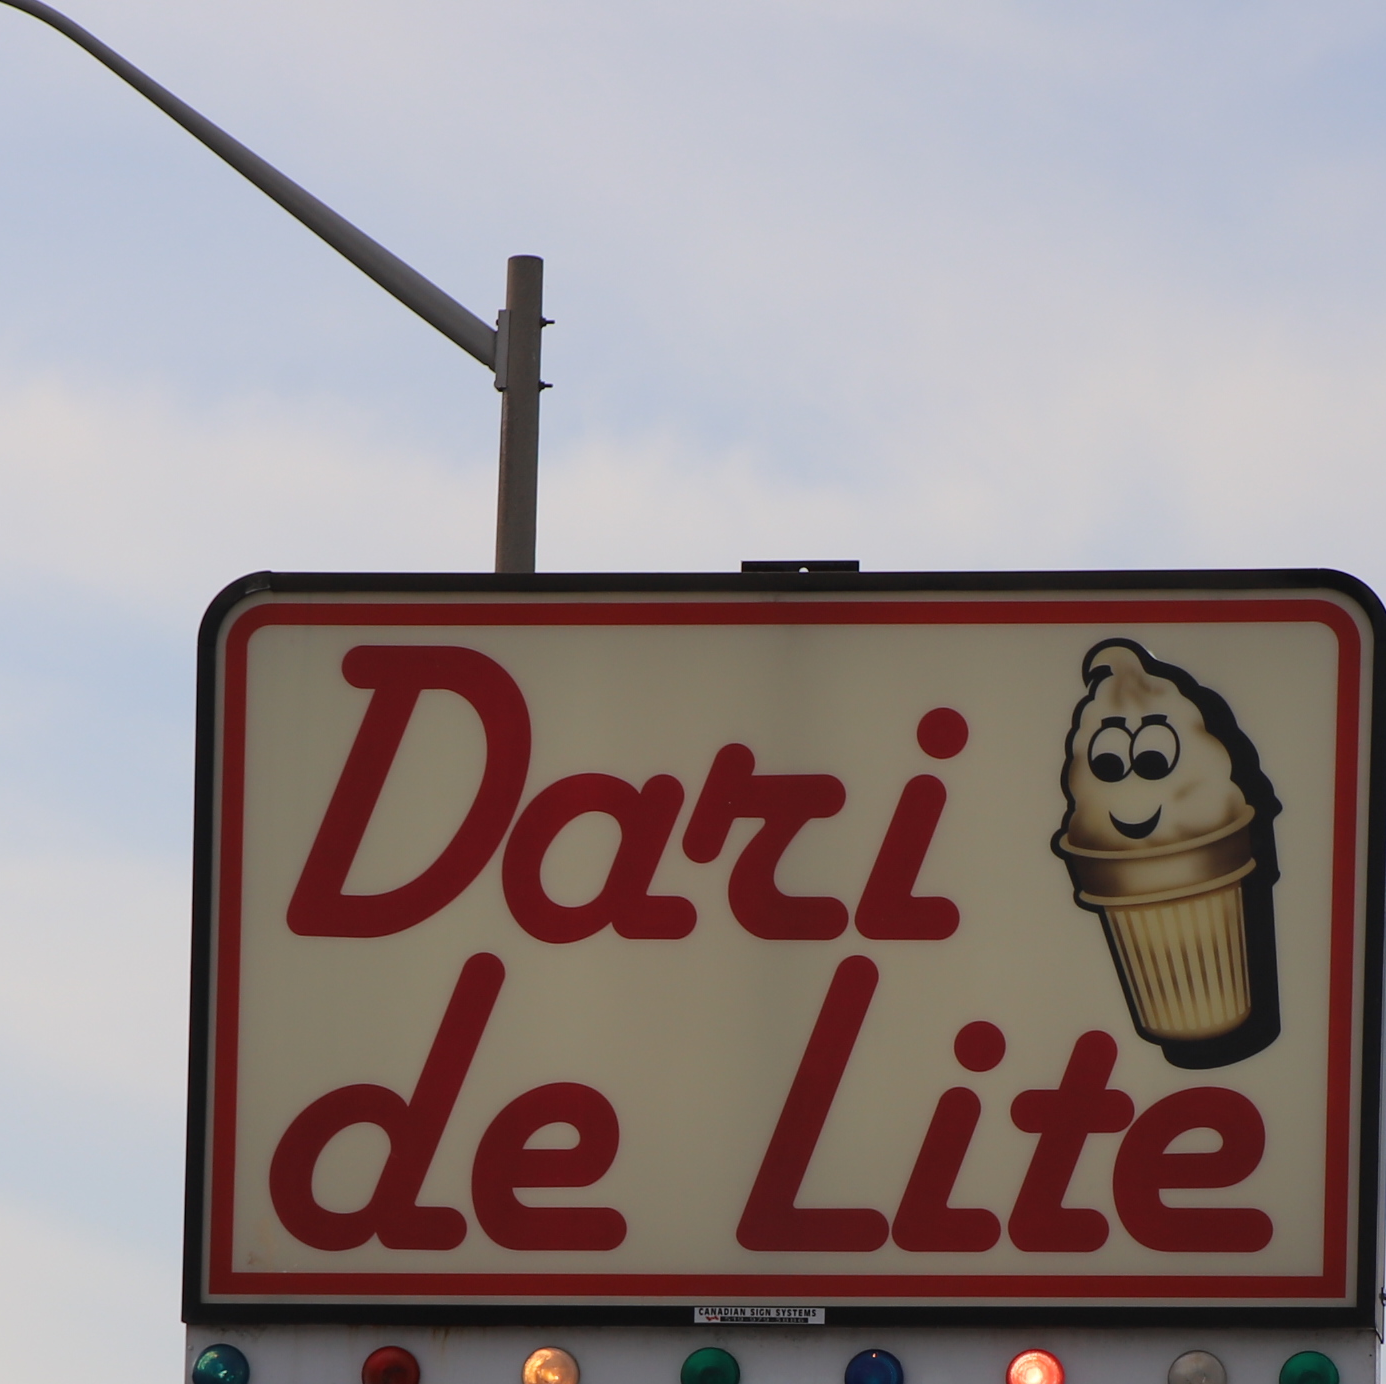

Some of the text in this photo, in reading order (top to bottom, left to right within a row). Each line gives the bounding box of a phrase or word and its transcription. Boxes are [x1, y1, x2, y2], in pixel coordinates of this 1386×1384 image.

[286, 644, 968, 944] Dari
[269, 951, 1274, 1253] de Lite
[698, 1307, 817, 1317] CANADIAN SIGN SYSTEMS
